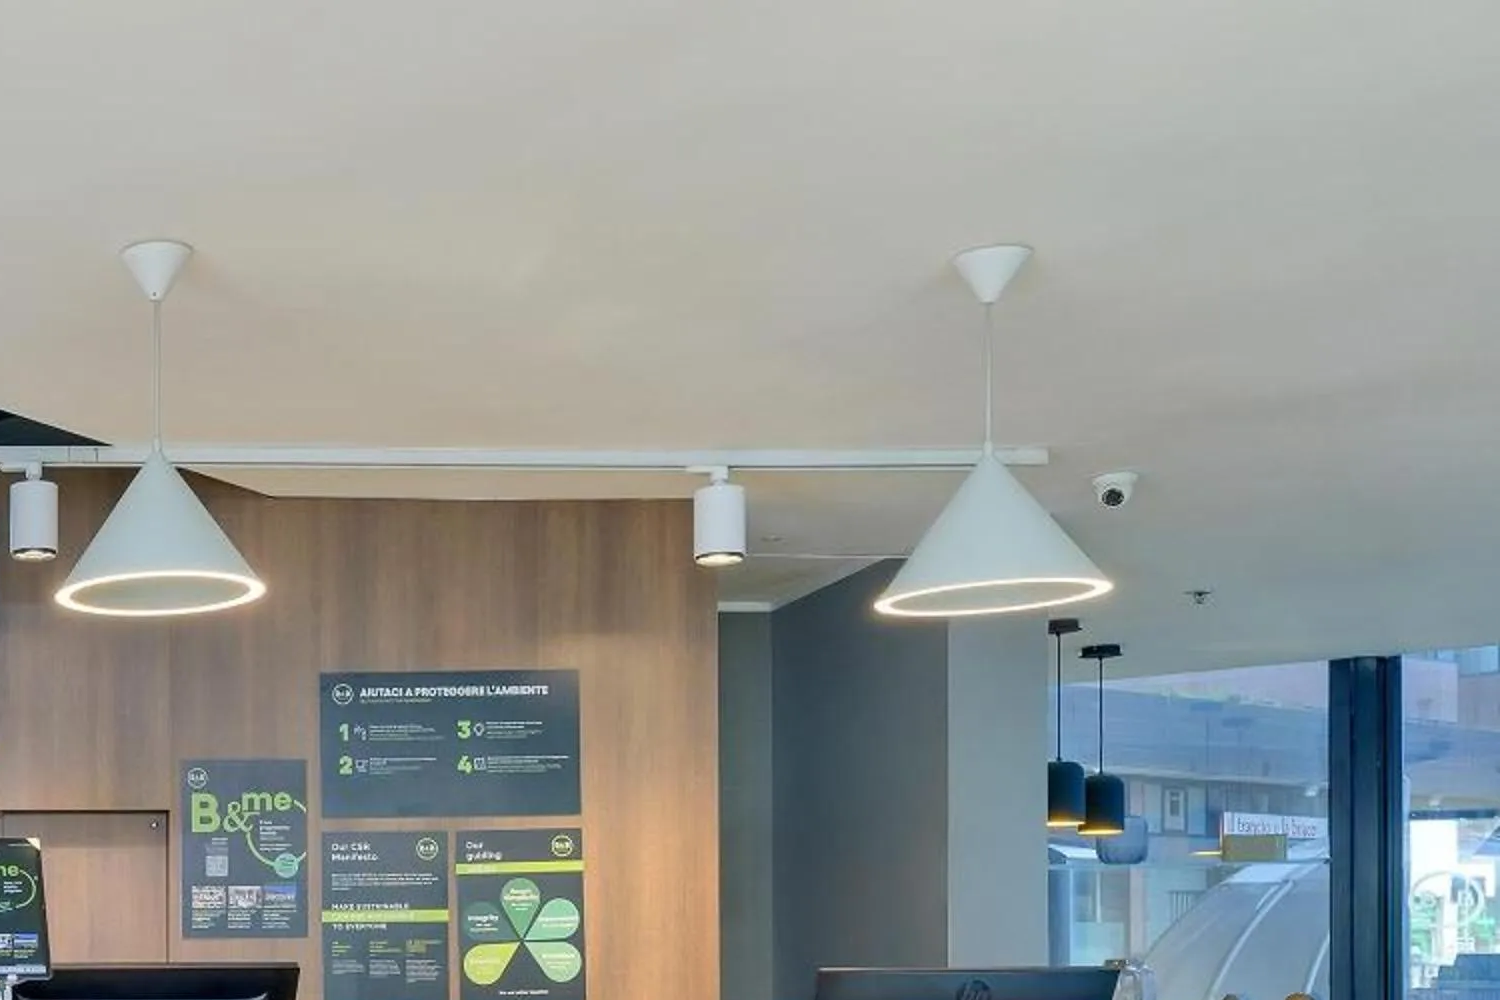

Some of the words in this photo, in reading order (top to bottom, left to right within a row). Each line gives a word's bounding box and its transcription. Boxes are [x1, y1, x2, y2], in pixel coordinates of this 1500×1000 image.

[359, 686, 403, 698] AIUTACI
[404, 687, 414, 698] A
[486, 685, 549, 696] L'AMBIENTE
[339, 723, 349, 741] 1
[457, 720, 471, 739] 3
[339, 756, 353, 775] 2
[457, 756, 473, 775] 4
